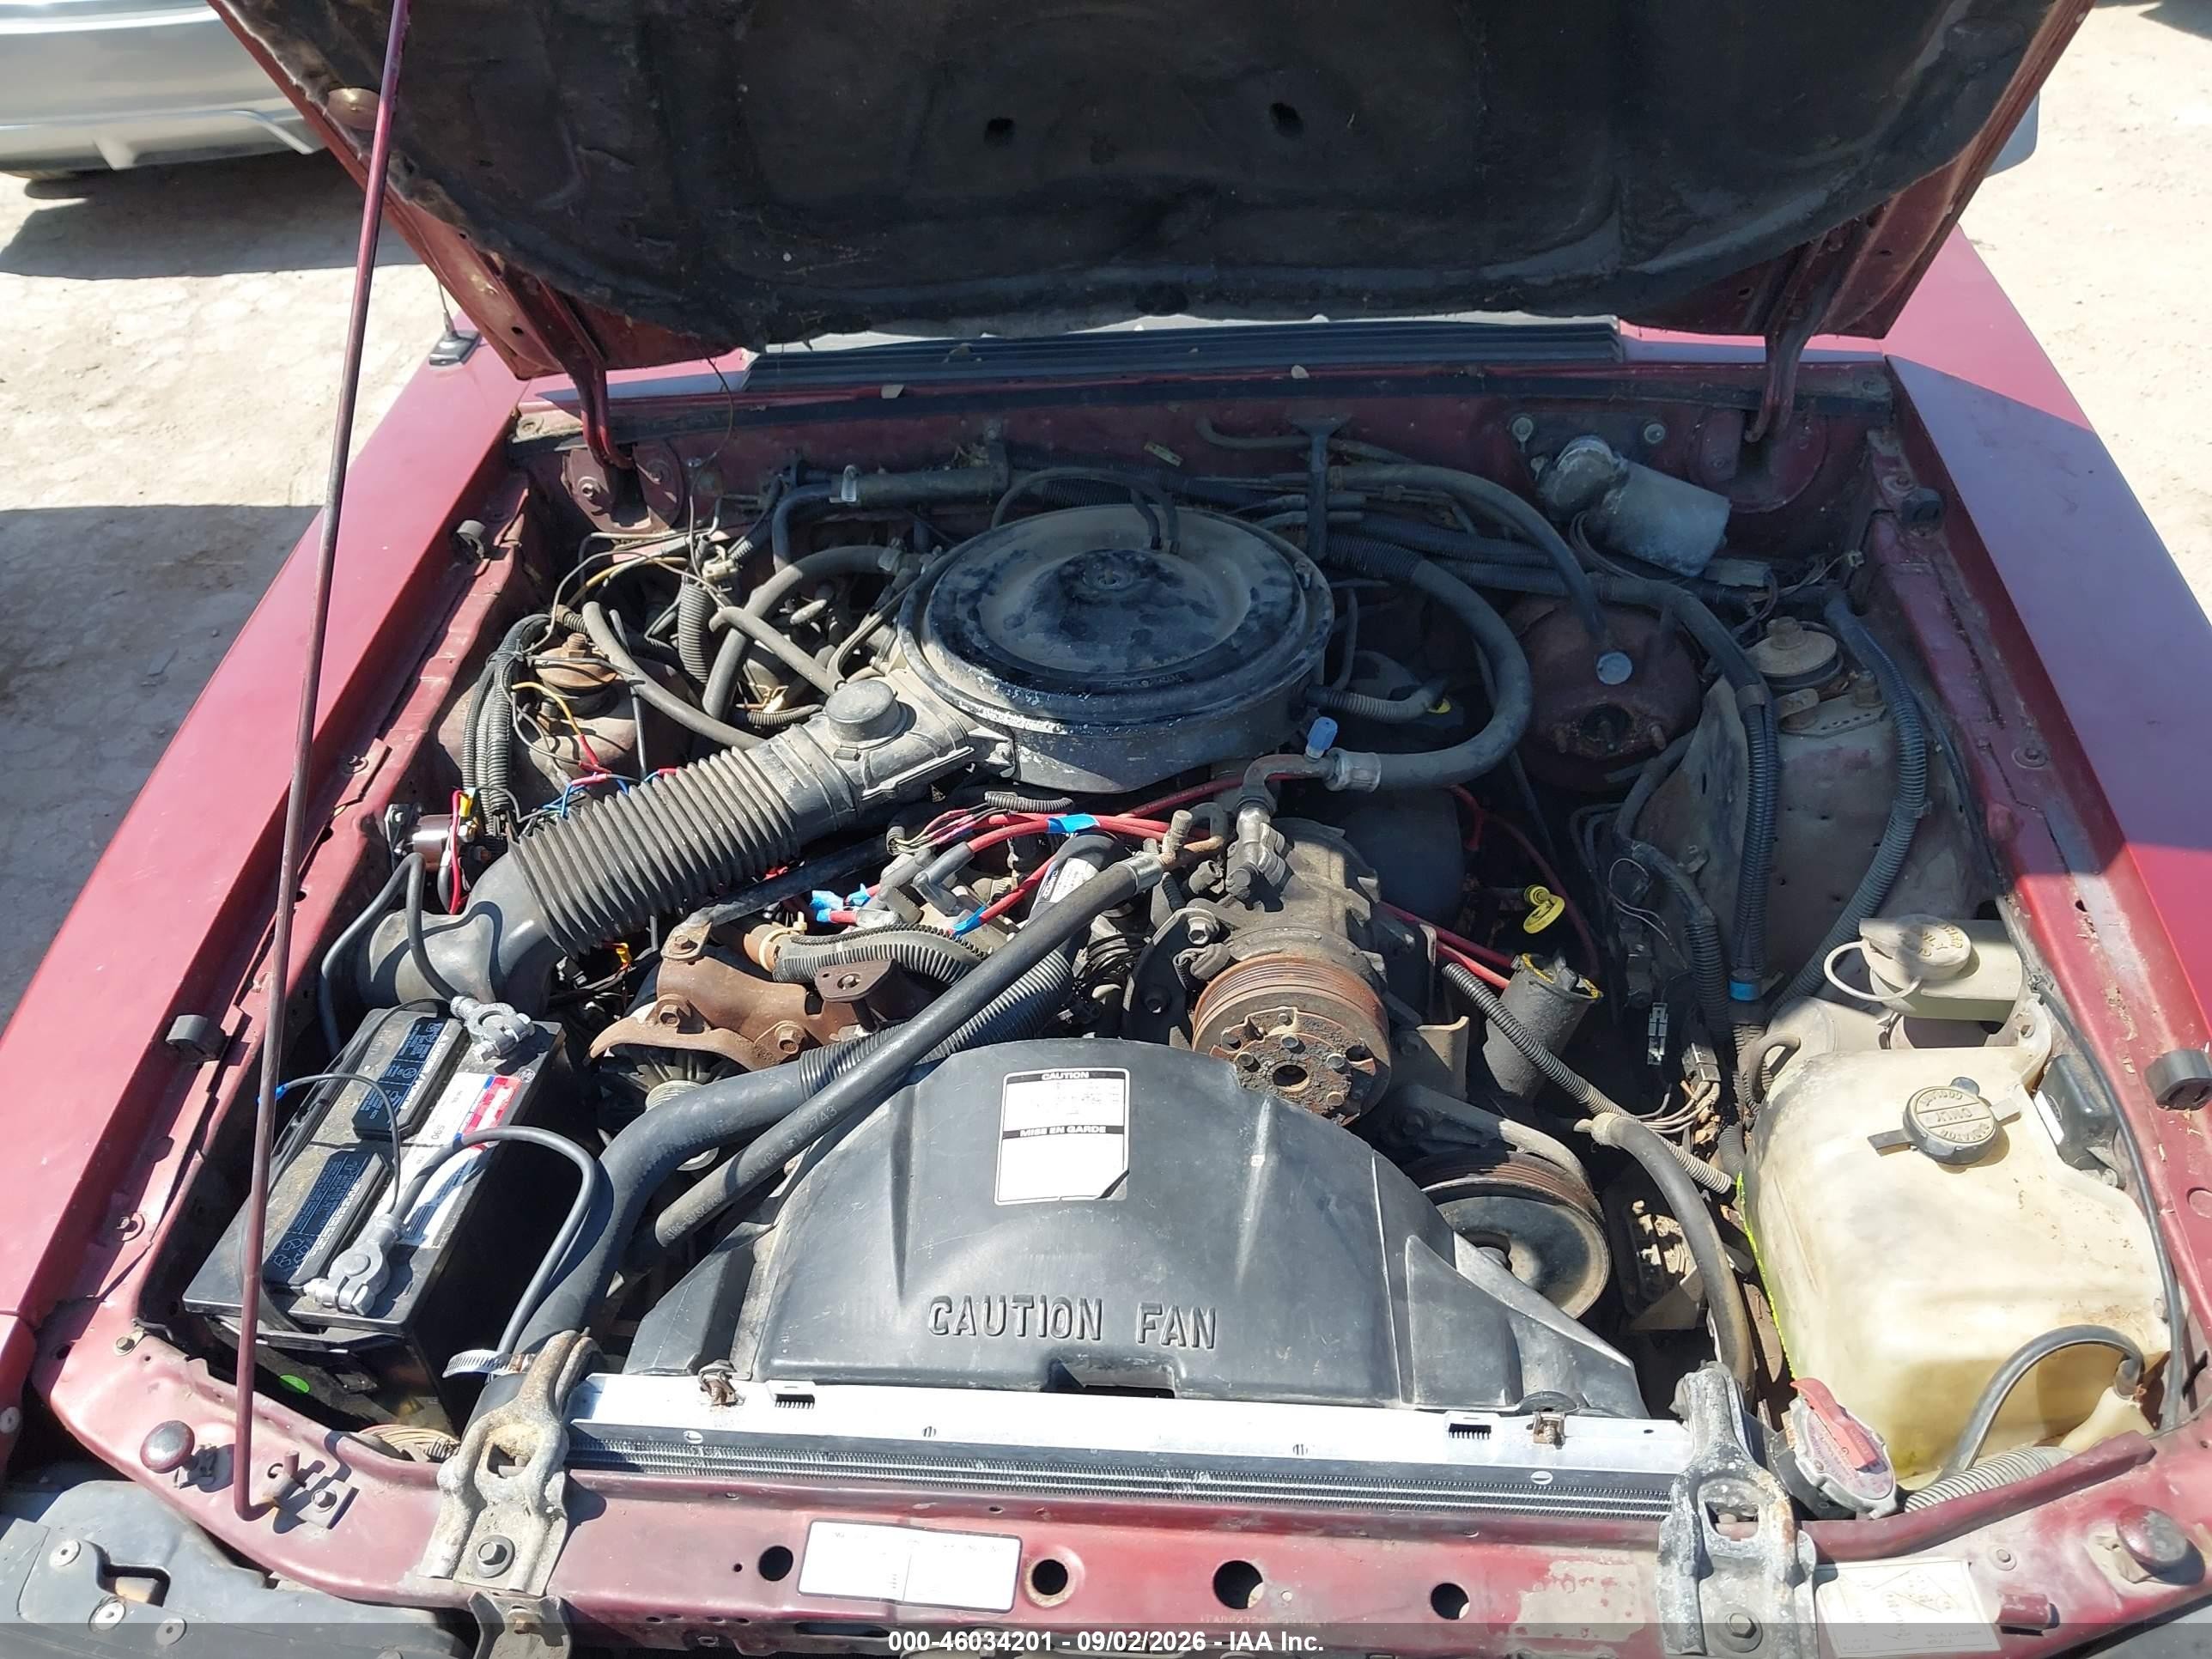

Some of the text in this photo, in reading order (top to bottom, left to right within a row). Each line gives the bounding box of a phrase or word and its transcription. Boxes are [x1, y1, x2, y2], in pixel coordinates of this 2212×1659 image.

[1041, 1071, 1090, 1081] CAUTION
[804, 1104, 838, 1133] 2743
[1019, 1126, 1107, 1138] MISE EN GARDE
[928, 1295, 1217, 1350] CAUTION FAN
